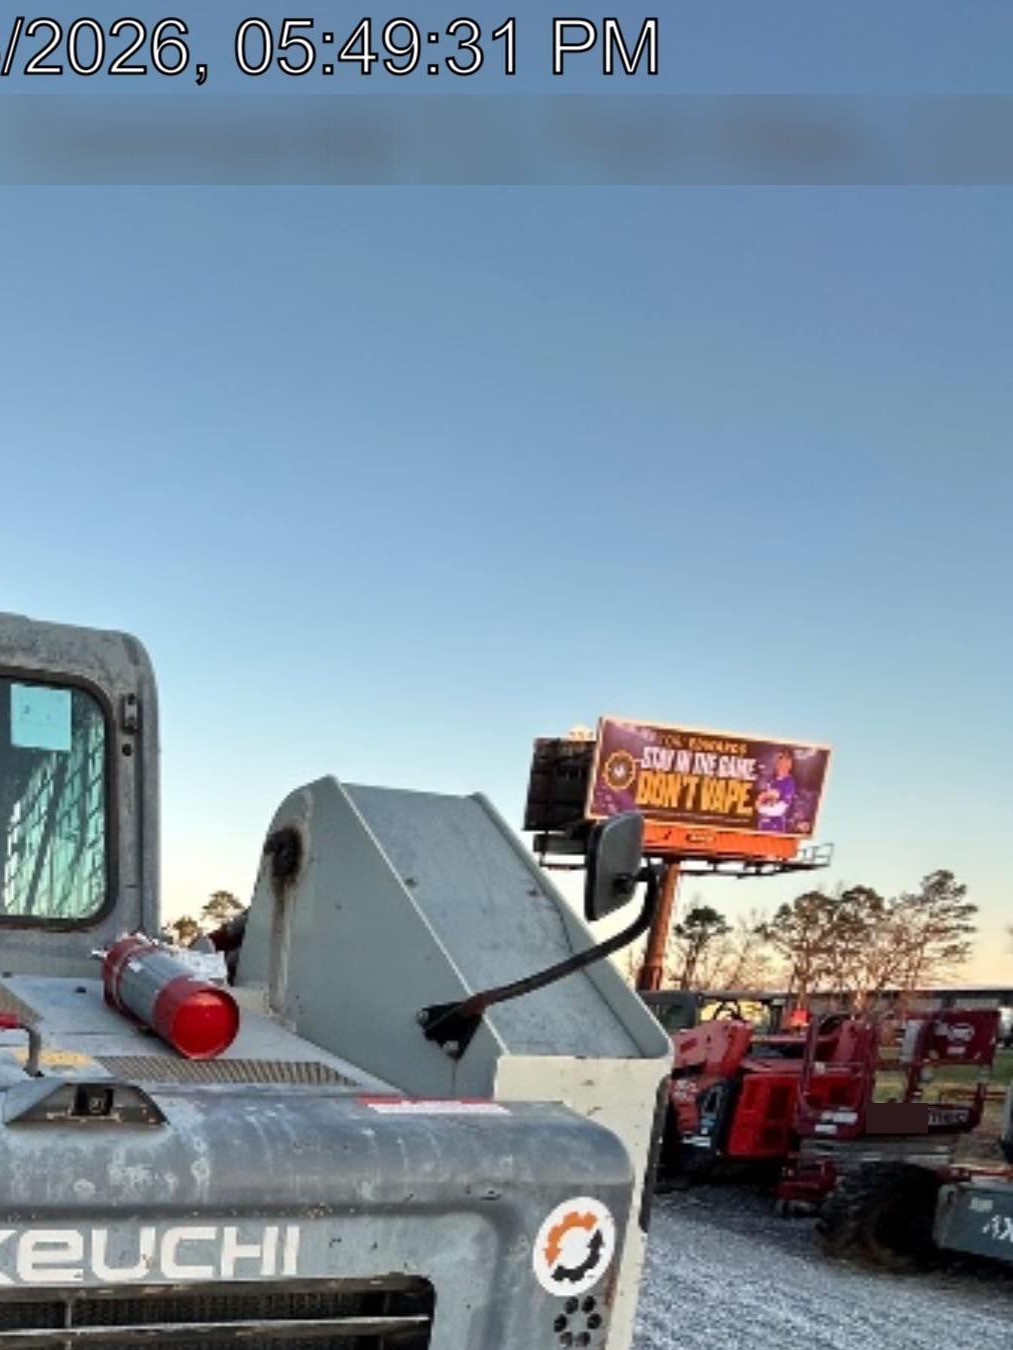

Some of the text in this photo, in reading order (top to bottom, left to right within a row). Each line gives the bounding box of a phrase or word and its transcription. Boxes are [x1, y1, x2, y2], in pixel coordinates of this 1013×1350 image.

[640, 745, 675, 771] STAY
[635, 769, 755, 816] DON'T VAPE
